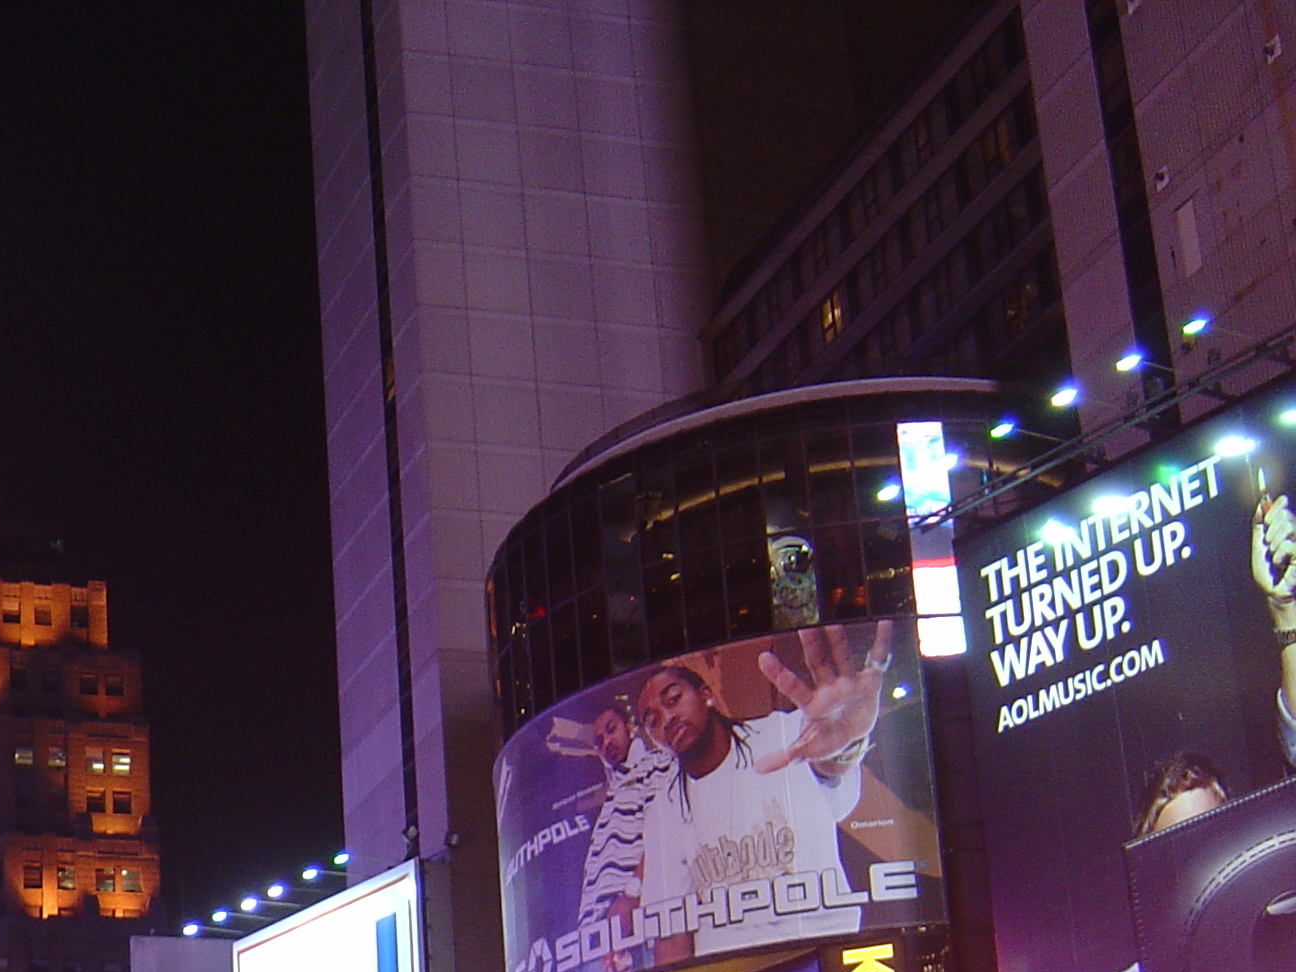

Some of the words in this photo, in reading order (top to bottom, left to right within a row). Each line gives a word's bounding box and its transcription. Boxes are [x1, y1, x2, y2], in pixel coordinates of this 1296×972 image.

[980, 540, 1048, 602] THE
[1053, 454, 1222, 572] INTERNET
[985, 549, 1127, 646] TURNED
[1133, 521, 1192, 577] UP.
[990, 617, 1069, 688] WAY
[1075, 595, 1131, 651] UP.
[996, 638, 1165, 733] AOLMUSIC.COM
[849, 816, 894, 831] Omarion
